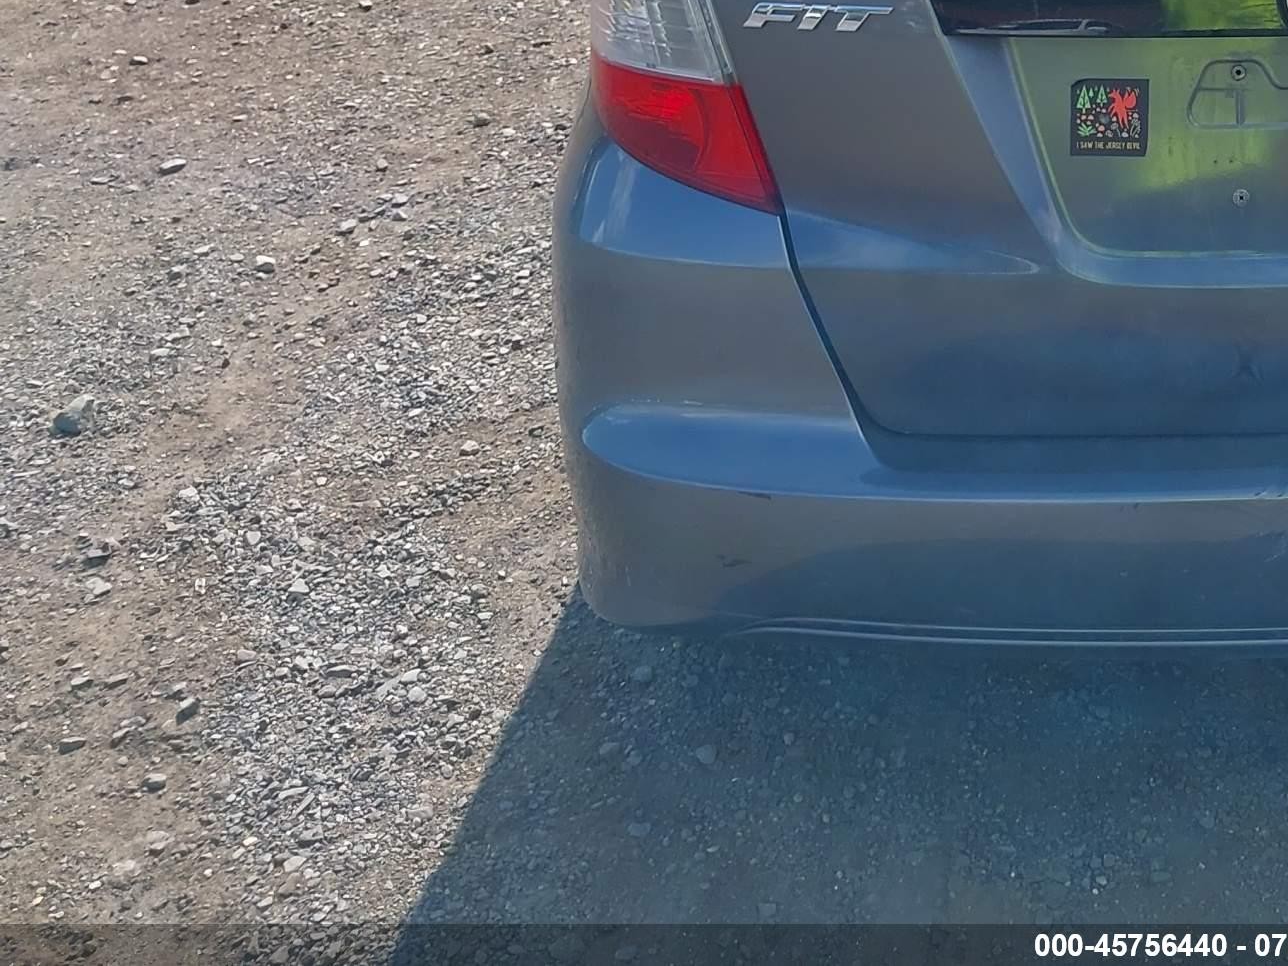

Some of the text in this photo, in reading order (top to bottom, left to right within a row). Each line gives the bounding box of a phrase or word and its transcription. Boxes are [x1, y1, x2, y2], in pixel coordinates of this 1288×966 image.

[743, 2, 894, 32] FIT
[1080, 141, 1093, 149] SAW
[1094, 141, 1104, 149] THE
[1105, 141, 1125, 149] JERSEY
[1126, 141, 1141, 150] DEVIL
